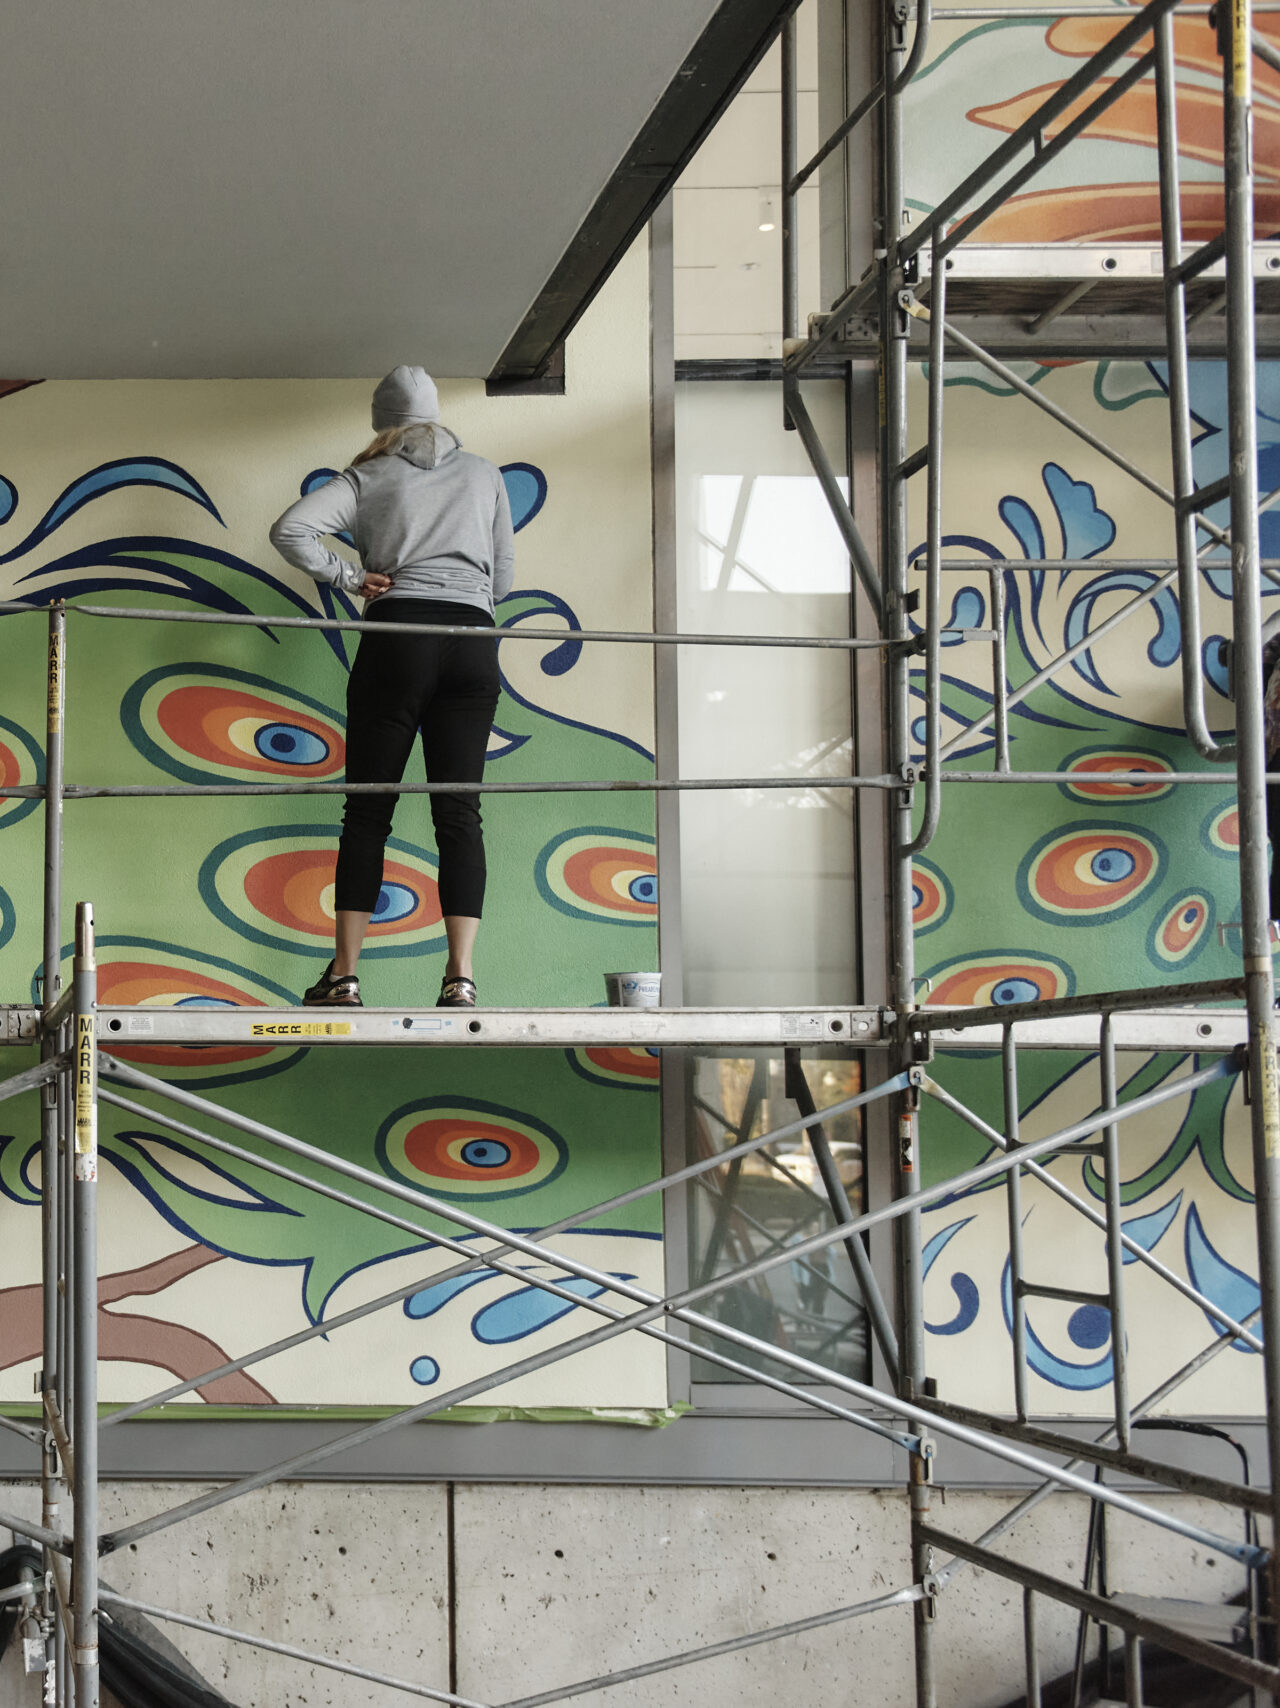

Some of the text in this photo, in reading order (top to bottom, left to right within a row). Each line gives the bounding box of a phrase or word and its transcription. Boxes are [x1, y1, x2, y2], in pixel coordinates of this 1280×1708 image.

[1236, 0, 1246, 29] RR
[49, 635, 59, 684] MARR
[253, 1025, 301, 1035] MARR
[80, 1018, 92, 1085] MARR
